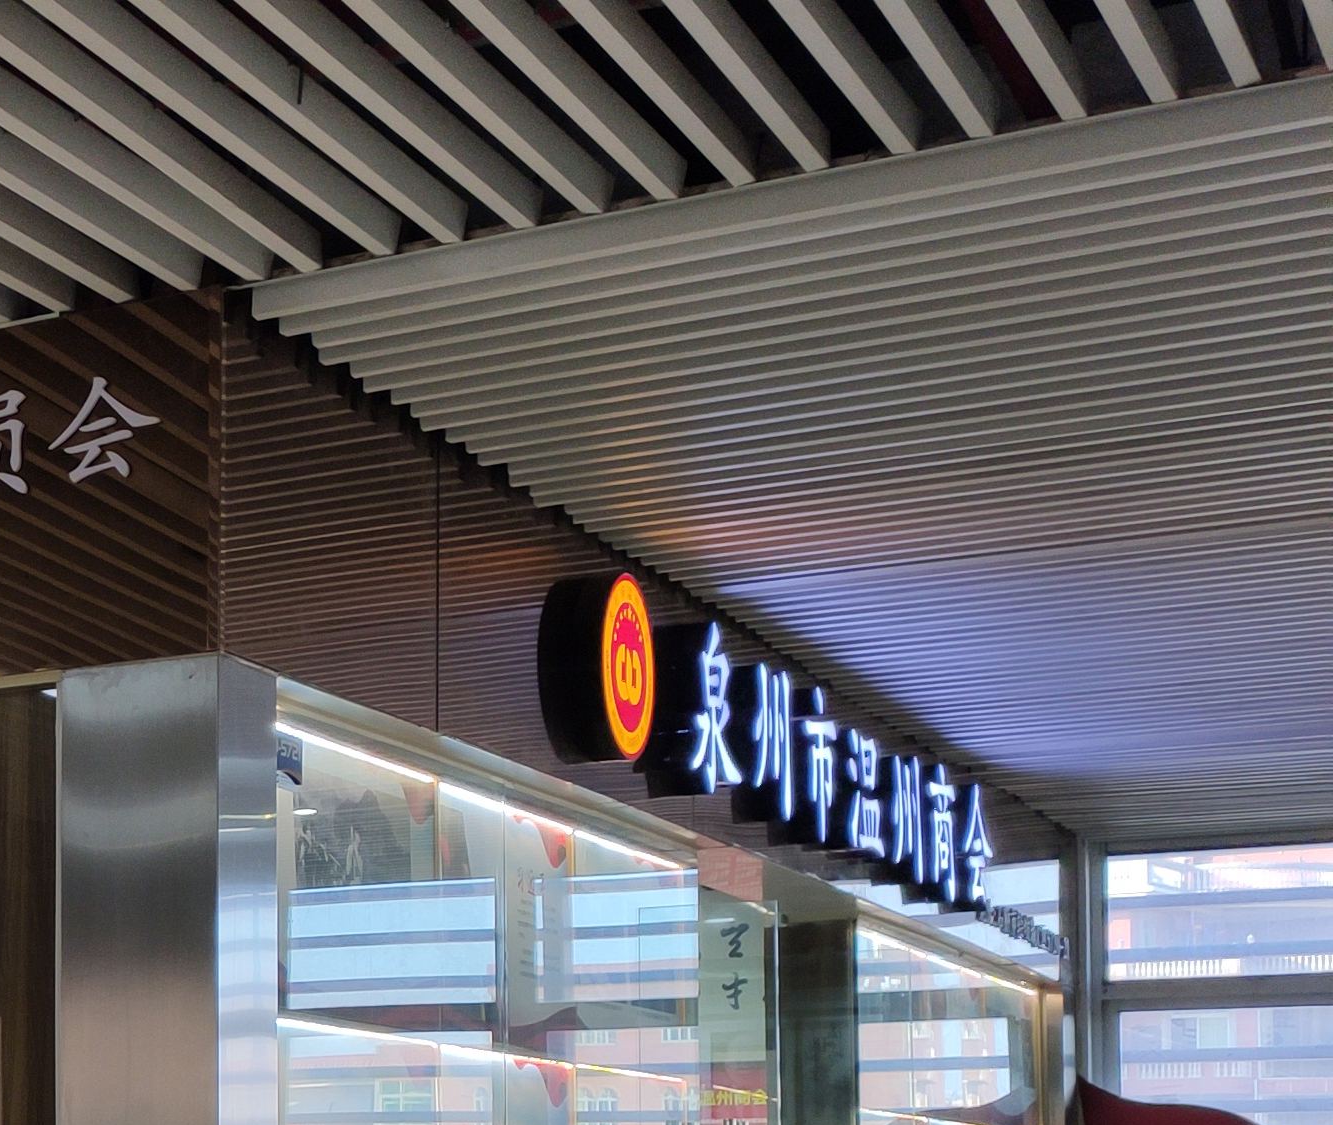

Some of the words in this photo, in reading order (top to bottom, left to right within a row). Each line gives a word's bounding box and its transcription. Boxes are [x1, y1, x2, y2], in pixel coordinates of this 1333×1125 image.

[689, 621, 993, 902] 泉州市温州商会
